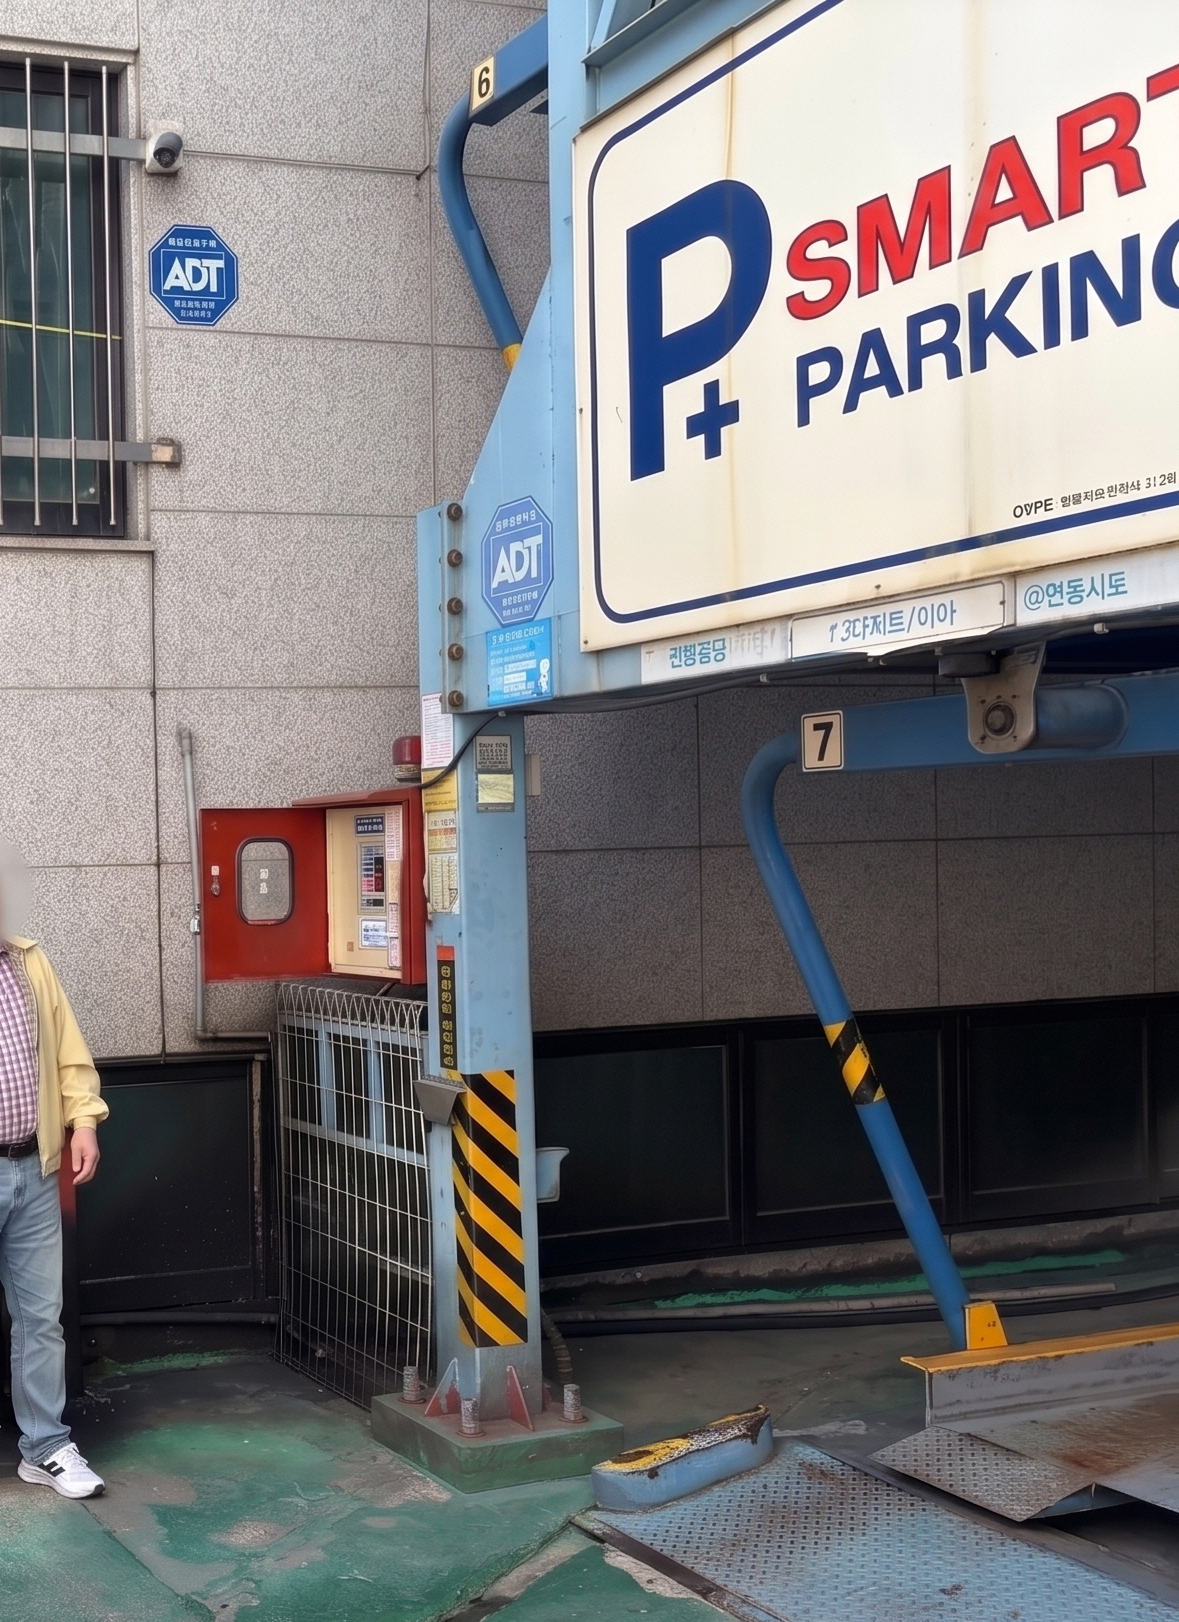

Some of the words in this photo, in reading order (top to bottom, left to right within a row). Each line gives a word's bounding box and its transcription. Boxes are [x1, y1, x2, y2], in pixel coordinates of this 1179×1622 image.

[478, 66, 490, 98] 6
[163, 256, 224, 293] ADT
[492, 534, 542, 589] ADT
[813, 721, 834, 762] 7
